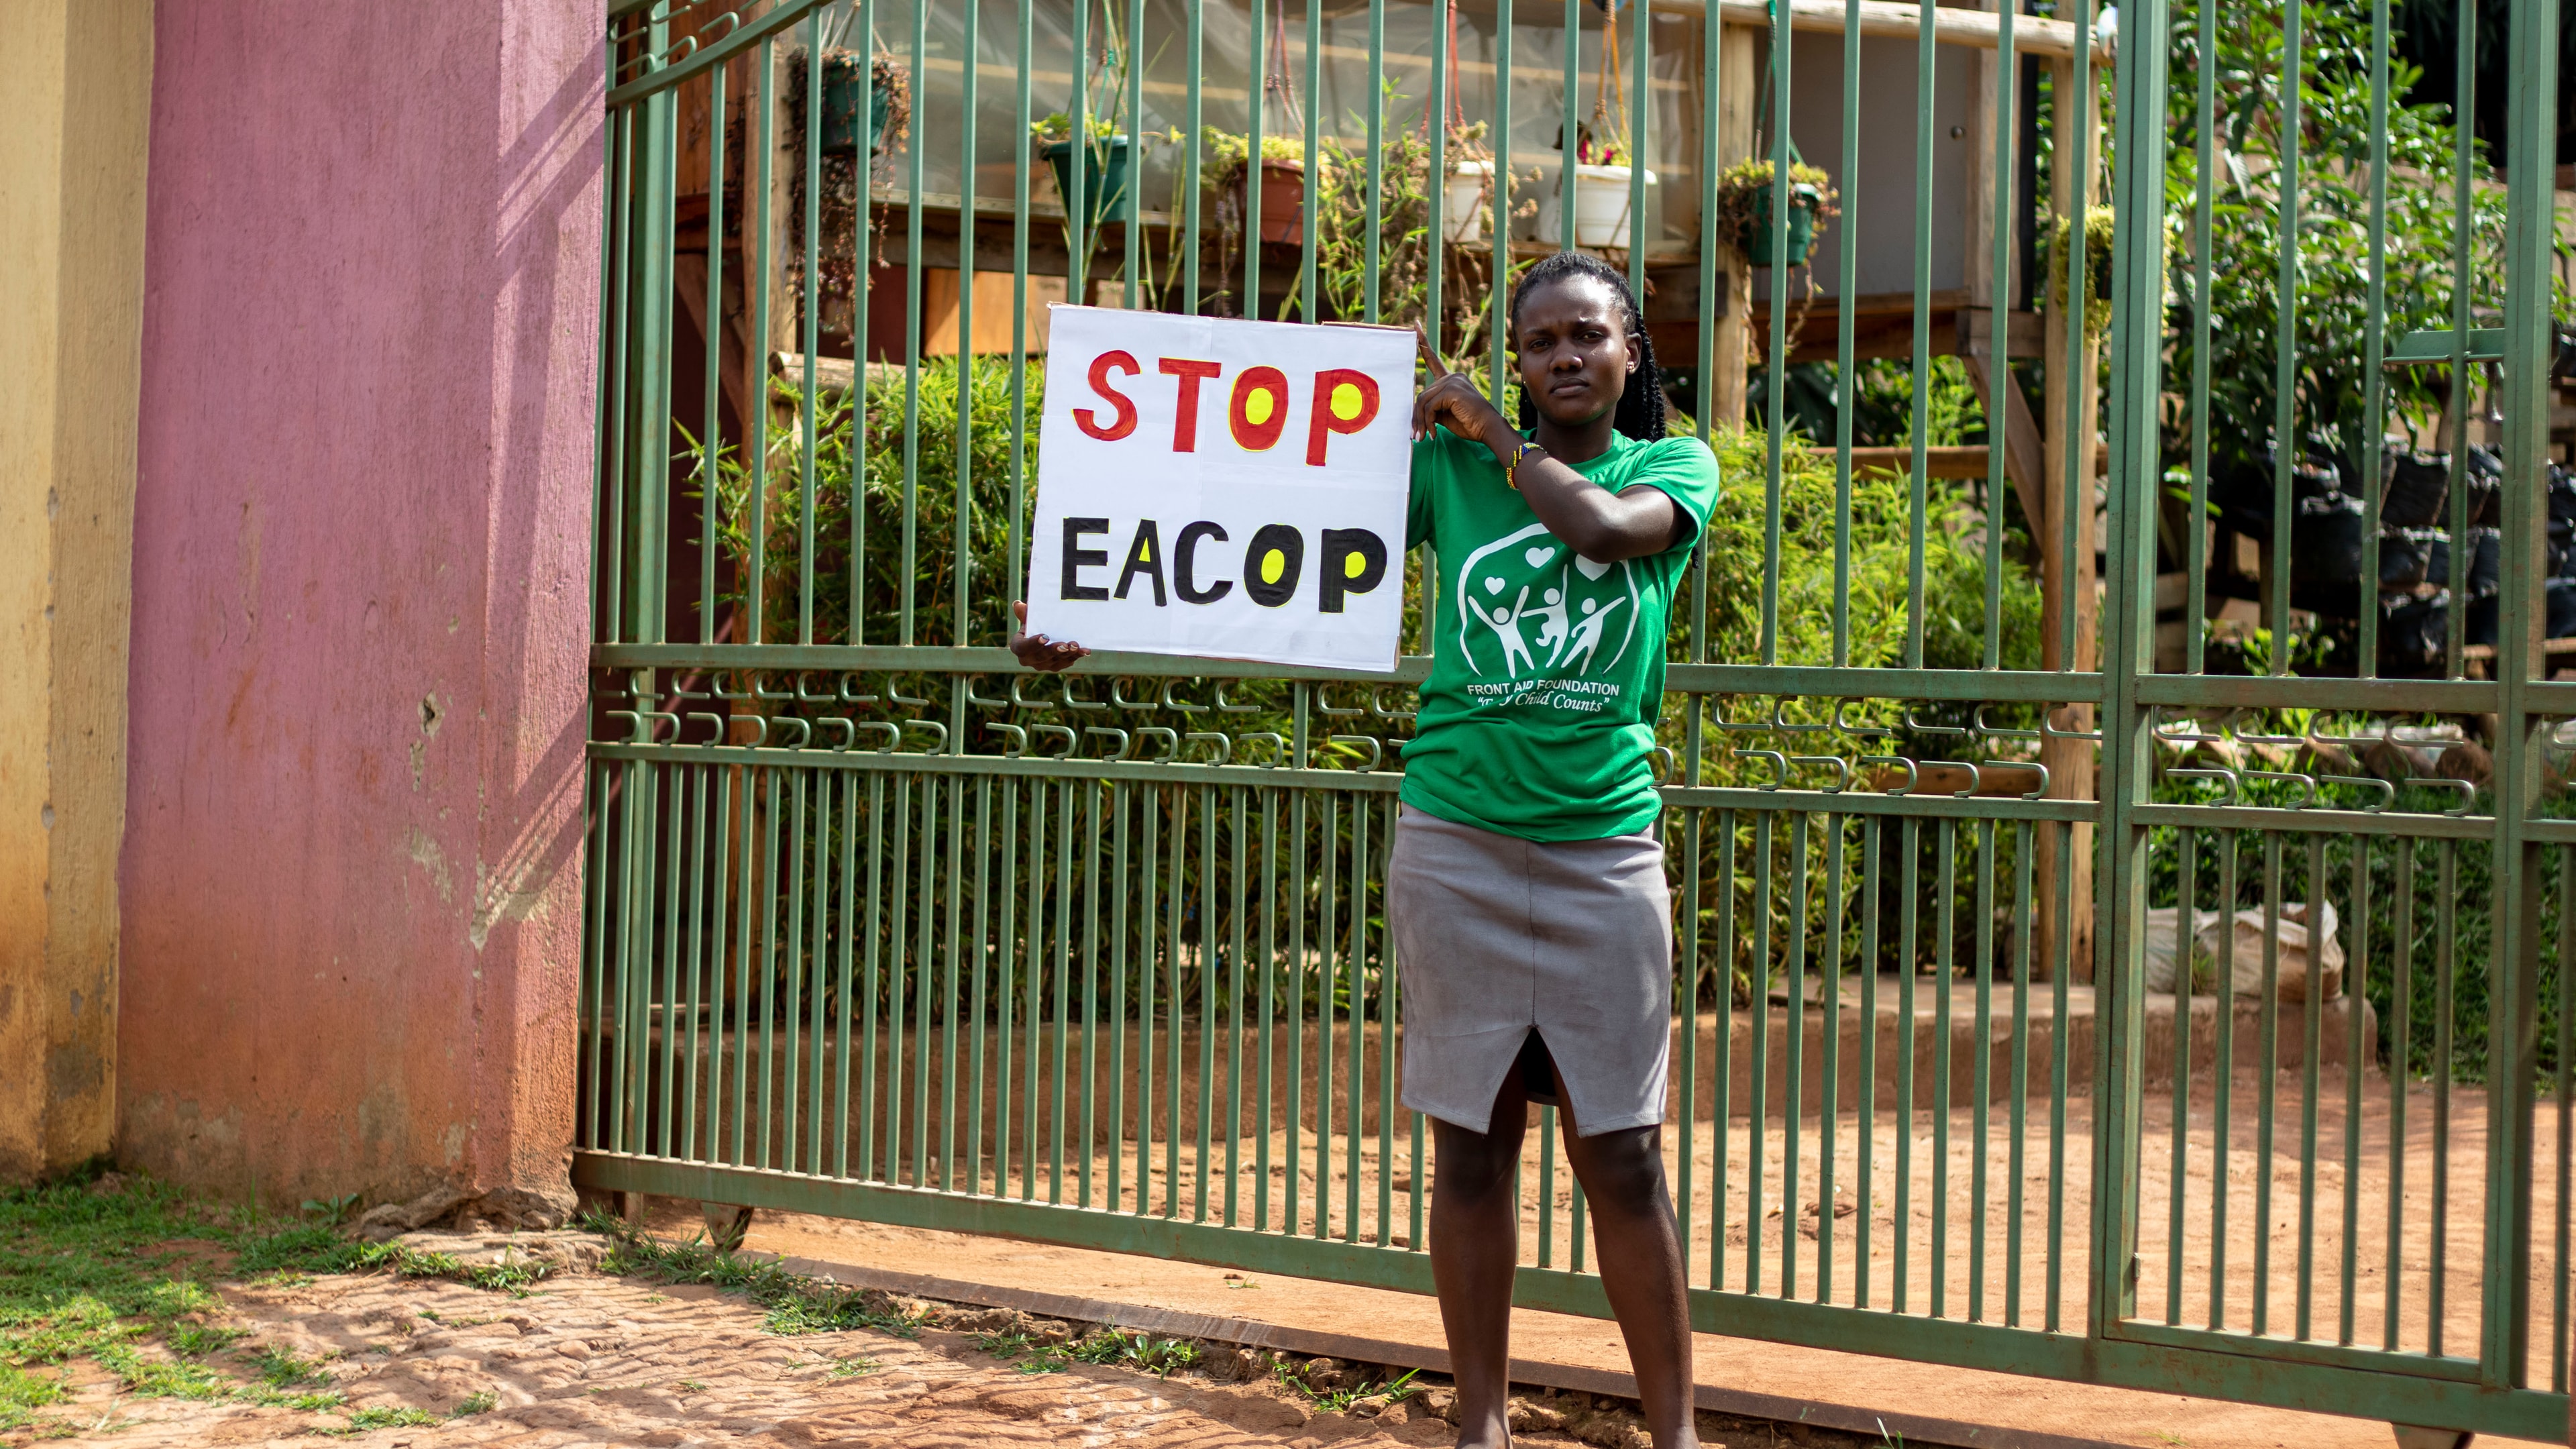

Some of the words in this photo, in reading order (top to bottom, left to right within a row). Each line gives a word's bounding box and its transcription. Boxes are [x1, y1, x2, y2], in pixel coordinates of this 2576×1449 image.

[1072, 350, 1381, 467] STOP
[1060, 517, 1388, 614] EACOP
[1466, 682, 1511, 696] FRONT
[1513, 680, 1534, 694] AID
[1536, 679, 1620, 696] FOUNDATION
[1515, 690, 1555, 706] Child
